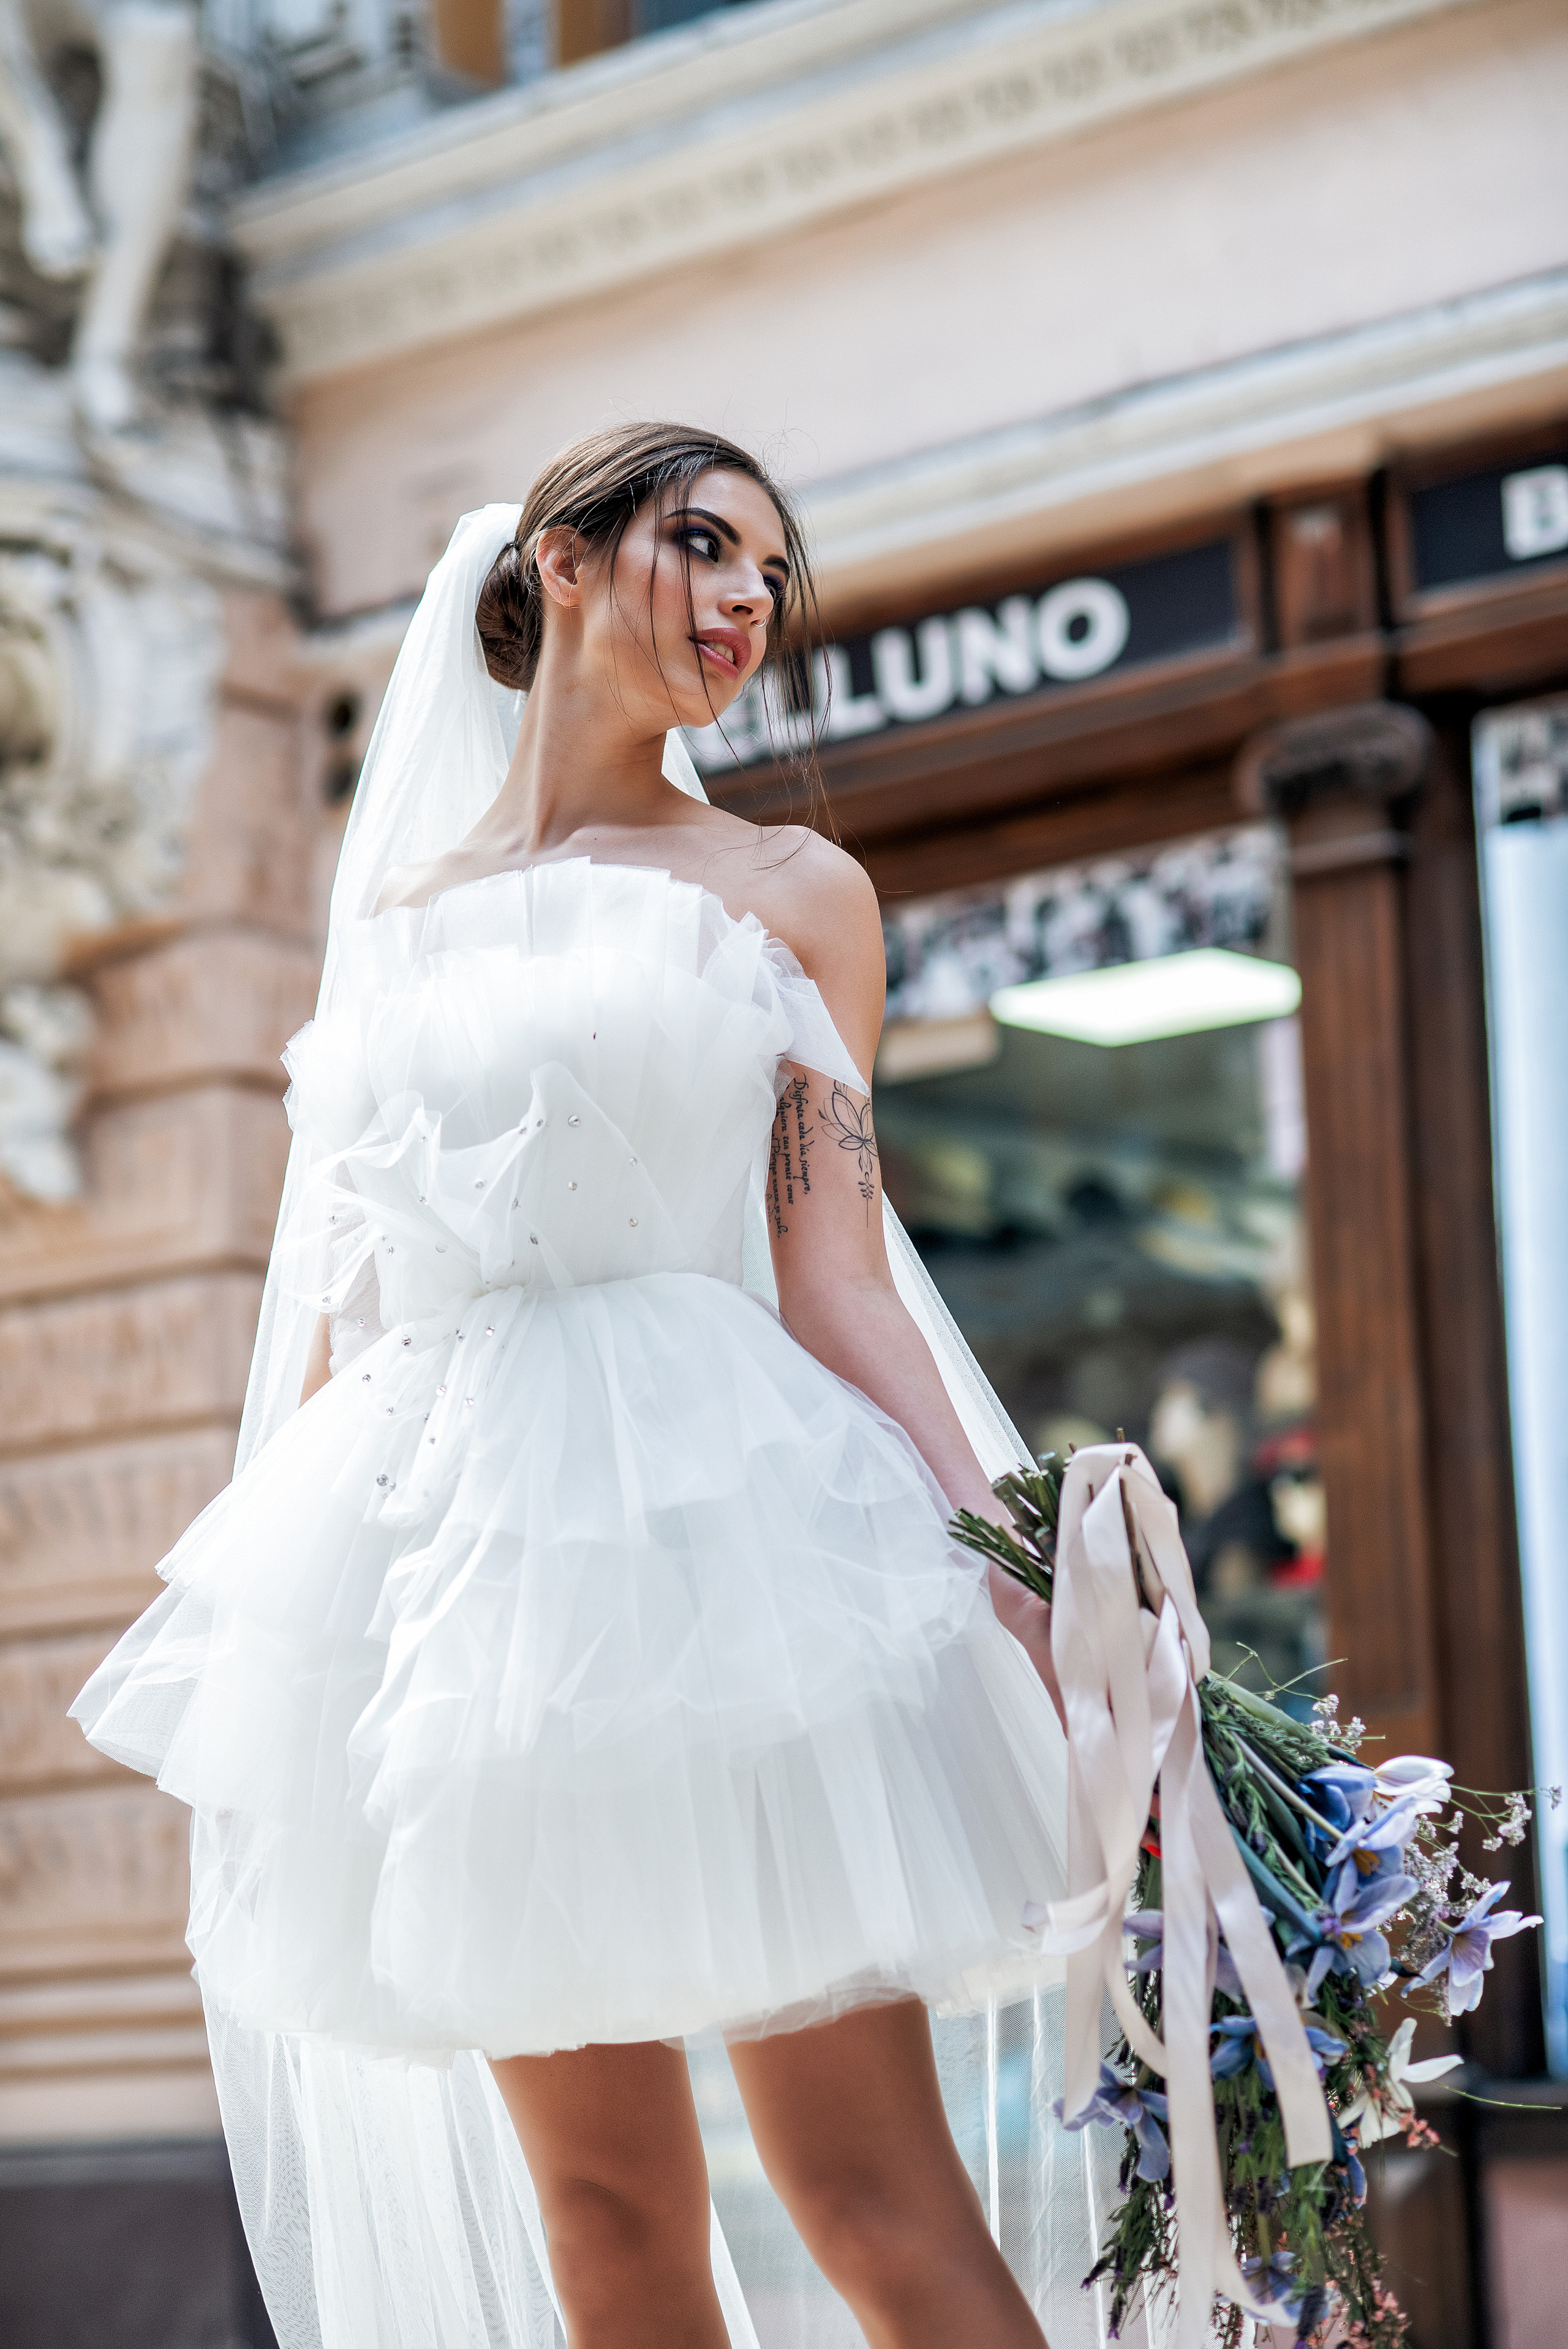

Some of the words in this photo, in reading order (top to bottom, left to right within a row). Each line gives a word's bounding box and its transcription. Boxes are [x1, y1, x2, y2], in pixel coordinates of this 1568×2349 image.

[789, 1072, 809, 1120] Disfruta
[798, 1122, 813, 1140] cada
[777, 1153, 792, 1181] pronto
[793, 1157, 811, 1194] siempre,
[774, 1203, 780, 1213] se
[774, 1215, 788, 1238] sabe,
